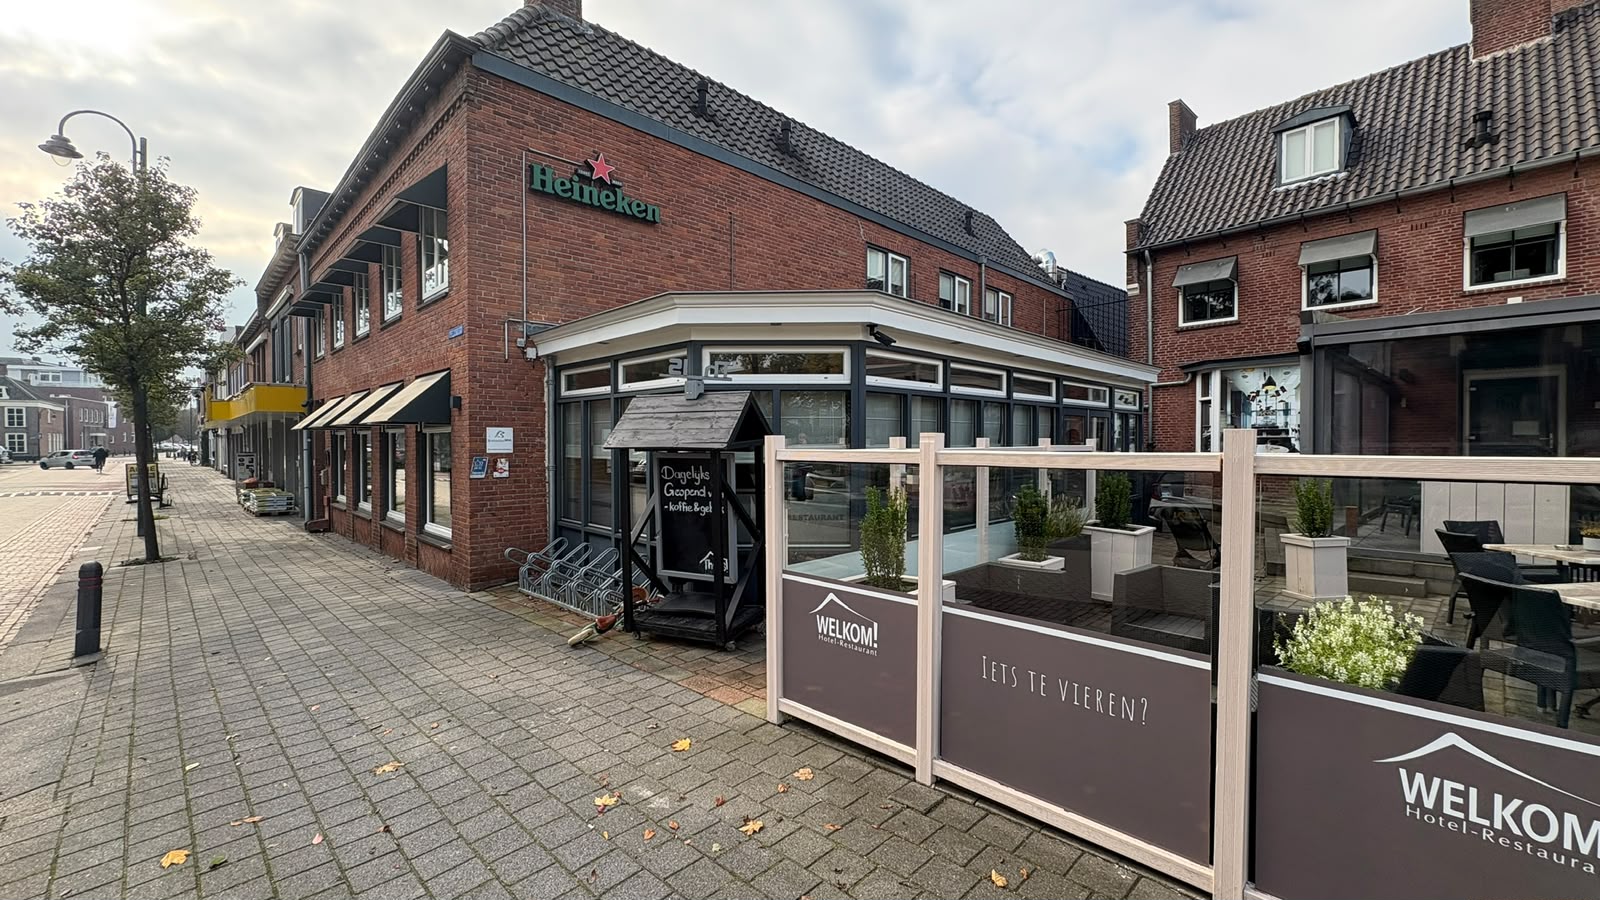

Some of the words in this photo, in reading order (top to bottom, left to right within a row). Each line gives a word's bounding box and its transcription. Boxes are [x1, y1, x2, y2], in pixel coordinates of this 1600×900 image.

[530, 164, 661, 223] Heineken
[664, 482, 706, 500] Geopend
[816, 614, 878, 648] WELKOM!
[818, 634, 878, 656] Hotel-Restaurant
[982, 655, 1017, 688] IETS
[1028, 670, 1047, 697] TE
[1058, 678, 1148, 725] VIEREN?
